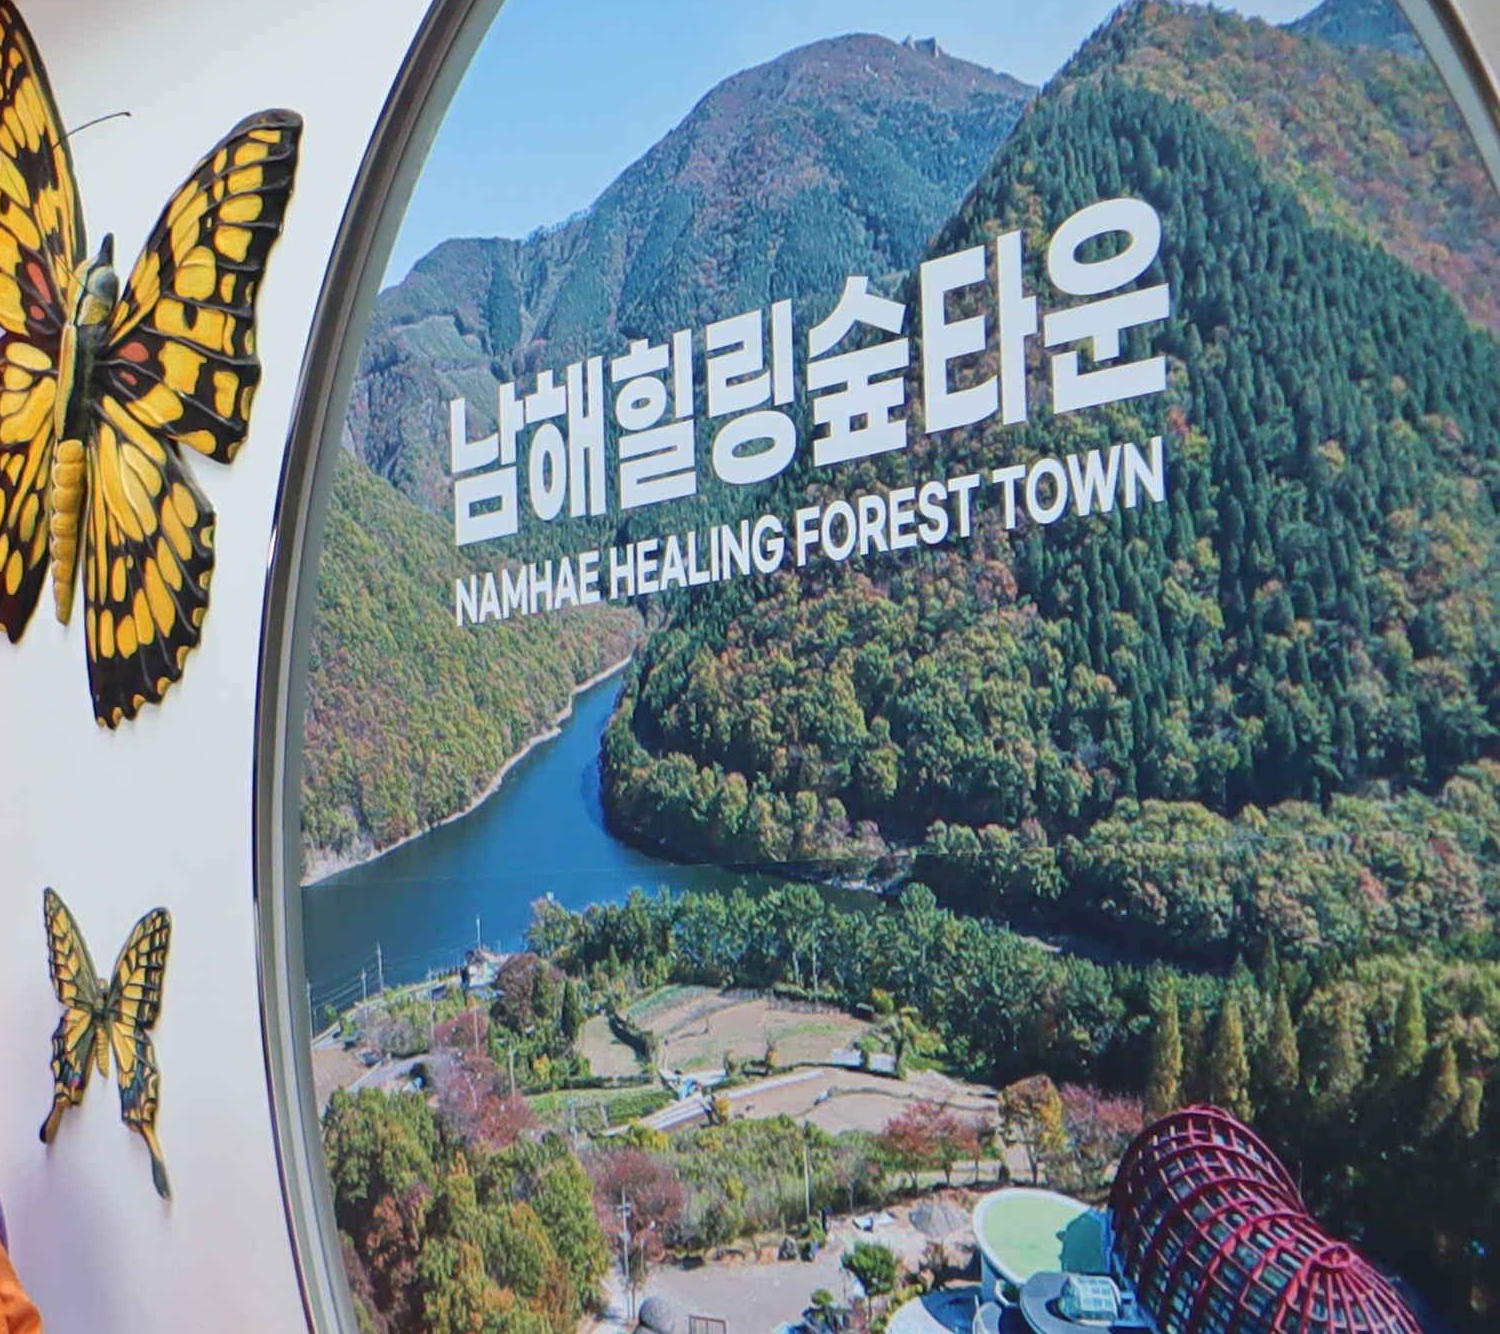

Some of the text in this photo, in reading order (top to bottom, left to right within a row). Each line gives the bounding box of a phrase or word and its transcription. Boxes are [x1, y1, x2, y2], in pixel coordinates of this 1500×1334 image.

[450, 196, 1171, 546] 남해힐링숲타운
[454, 436, 1165, 627] NAMHAE HEALING FOREST TOWN
